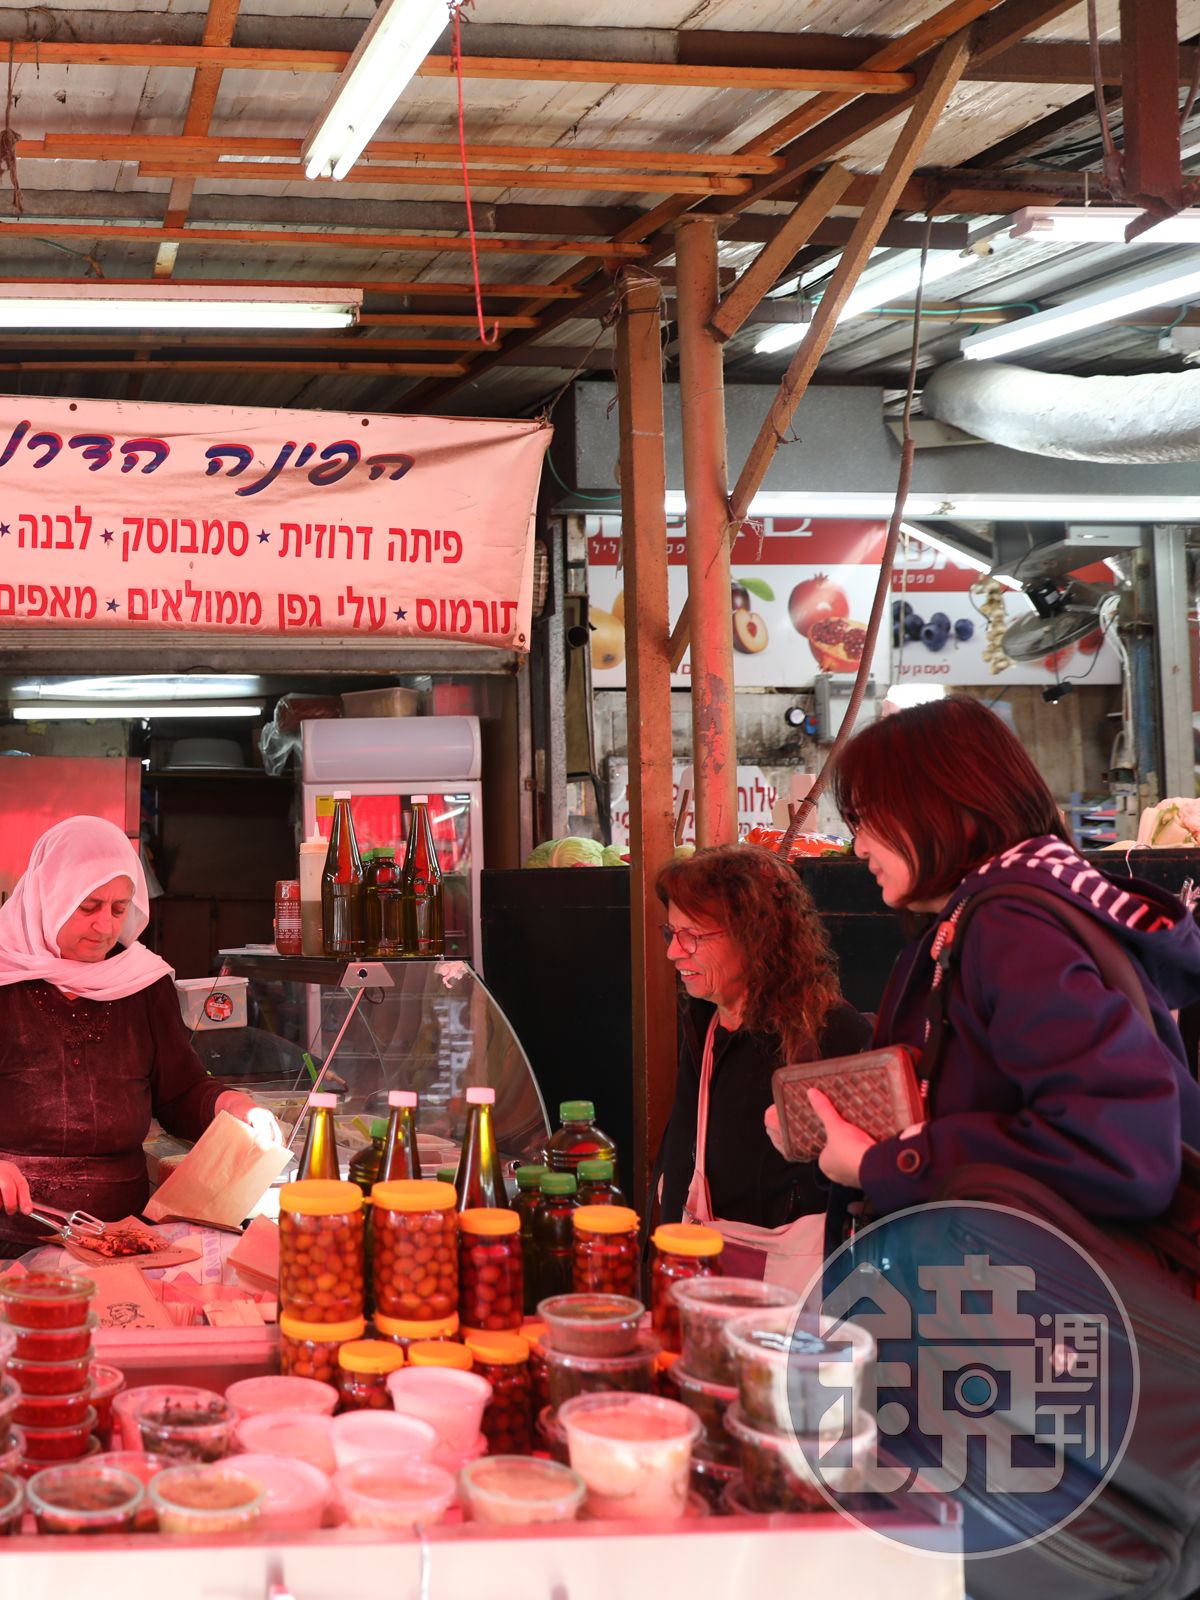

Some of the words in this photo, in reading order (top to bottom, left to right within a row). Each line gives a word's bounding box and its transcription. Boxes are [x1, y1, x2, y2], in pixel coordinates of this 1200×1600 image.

[205, 441, 415, 496] הפינה
[19, 506, 92, 549] לבנה
[122, 518, 249, 562] סמבוסק
[279, 523, 372, 561] דרוזית
[388, 527, 463, 564] פיתה
[128, 579, 262, 626] ממולאים
[277, 594, 322, 631] גפן
[337, 582, 387, 631] עלי
[415, 598, 518, 634] תורמוס
